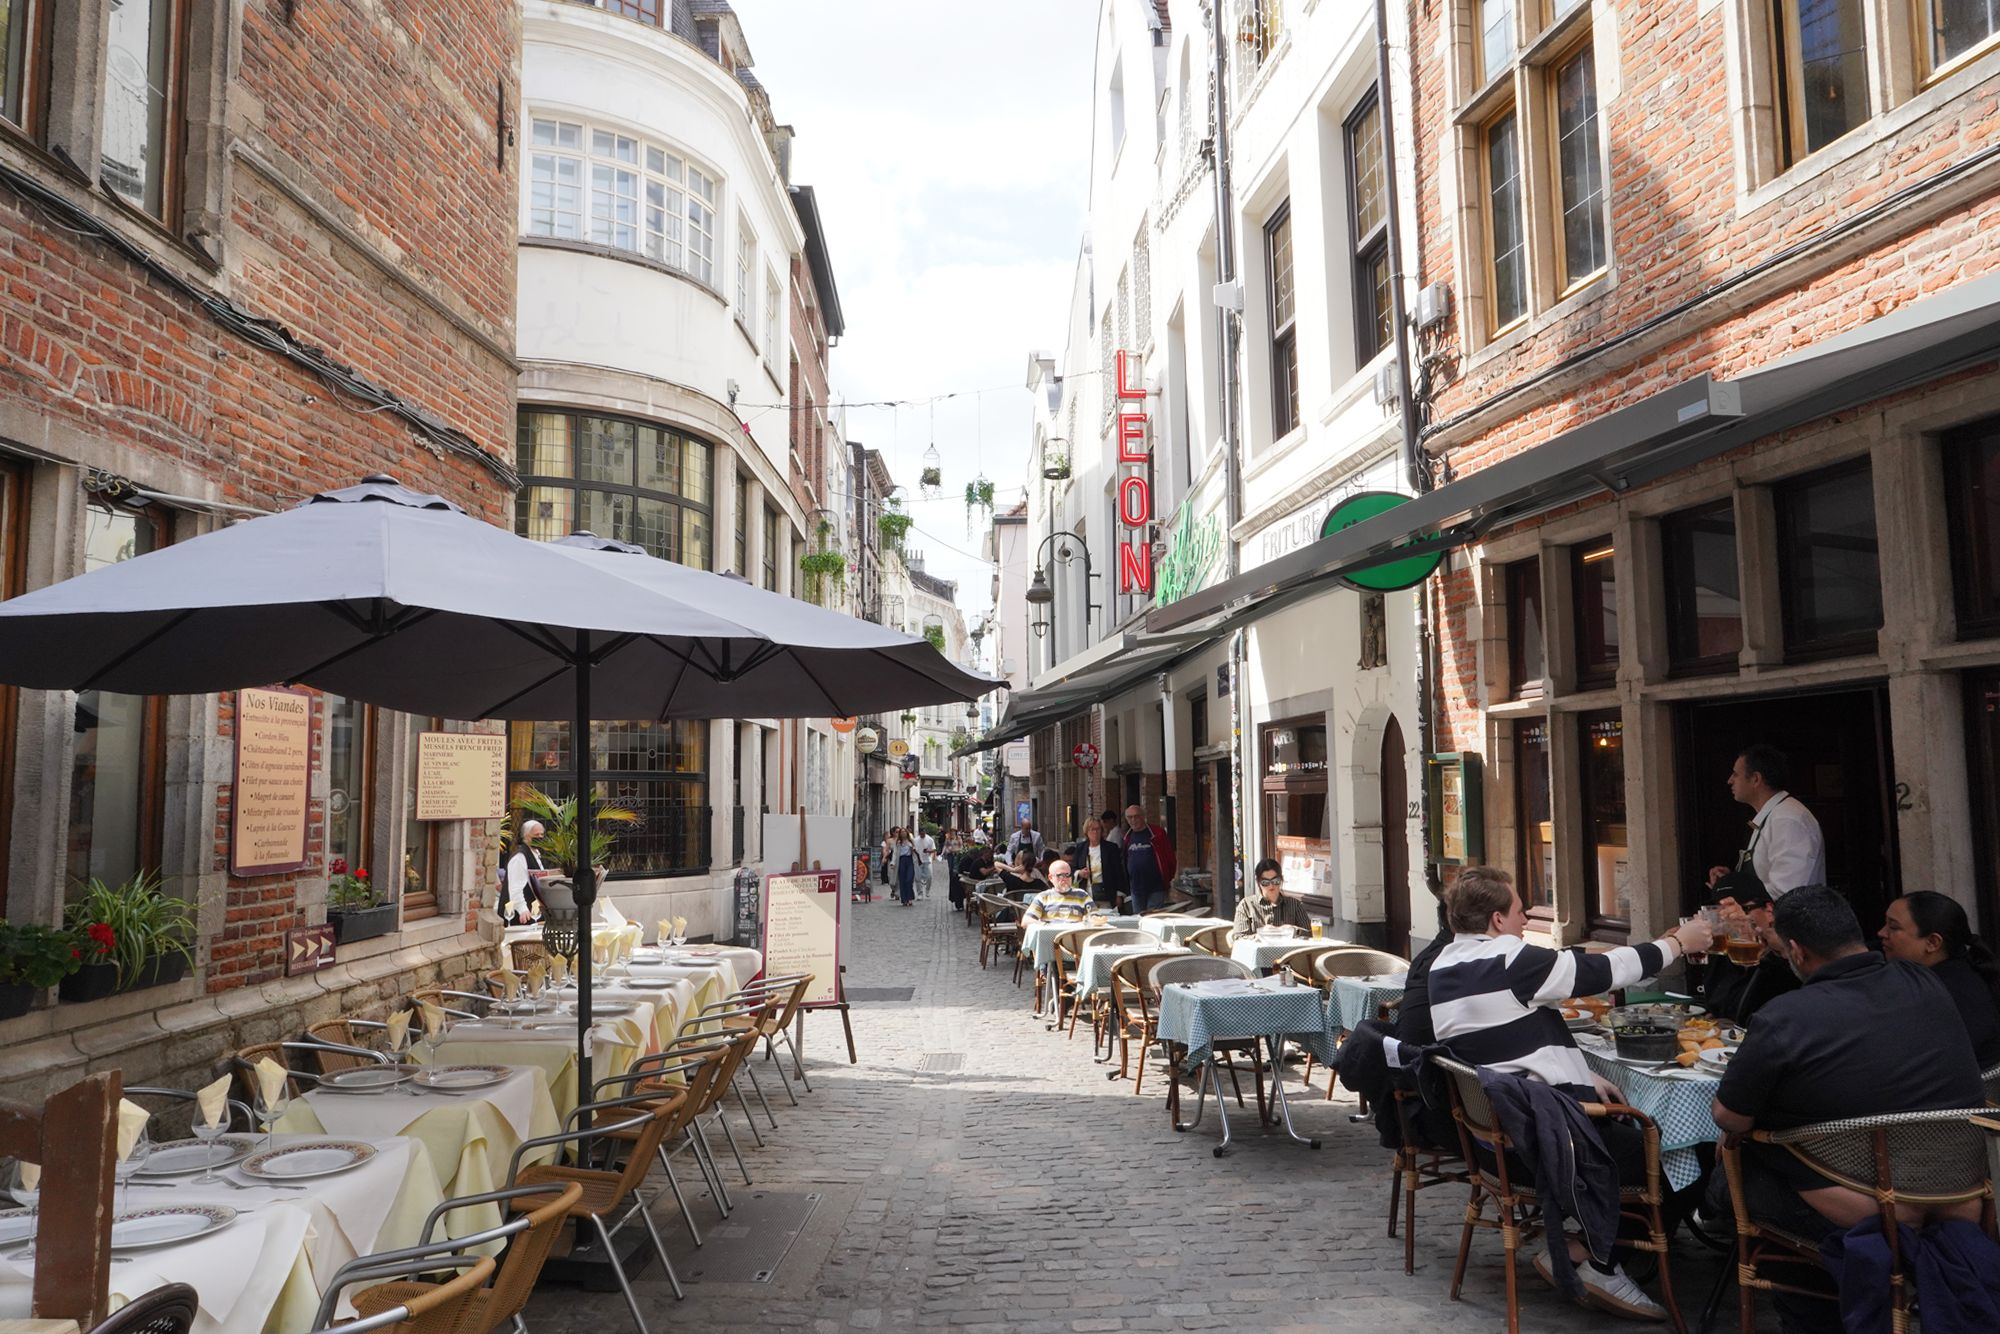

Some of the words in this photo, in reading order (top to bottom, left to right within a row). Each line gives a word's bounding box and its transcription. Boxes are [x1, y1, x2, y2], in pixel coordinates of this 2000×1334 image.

[1116, 350, 1151, 592] LEON
[1262, 508, 1321, 563] FRITURE
[246, 692, 266, 710] Nos
[268, 696, 304, 714] Viandes
[424, 736, 456, 744] MOULES
